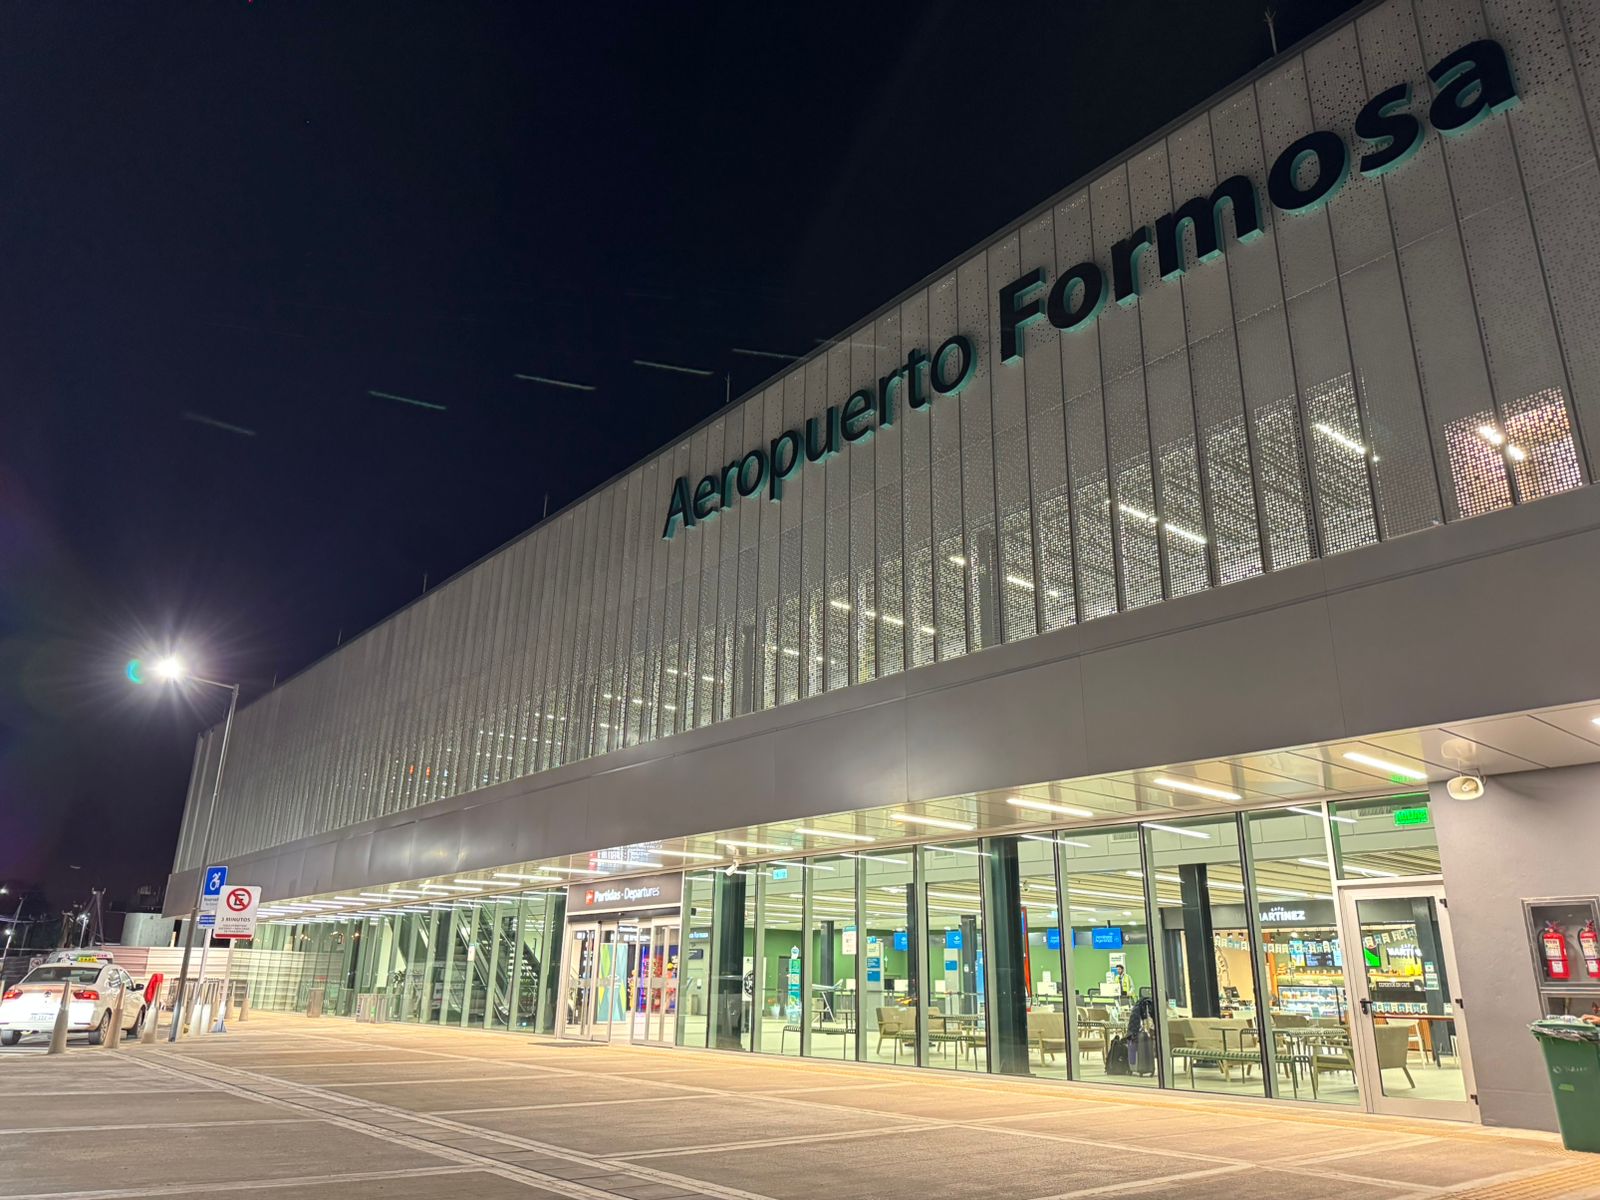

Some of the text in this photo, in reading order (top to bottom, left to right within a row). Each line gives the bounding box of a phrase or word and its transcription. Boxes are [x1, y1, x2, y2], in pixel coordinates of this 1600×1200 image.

[662, 39, 1519, 541] Aeropuerto Formosa
[594, 886, 660, 902] Partidas Departures
